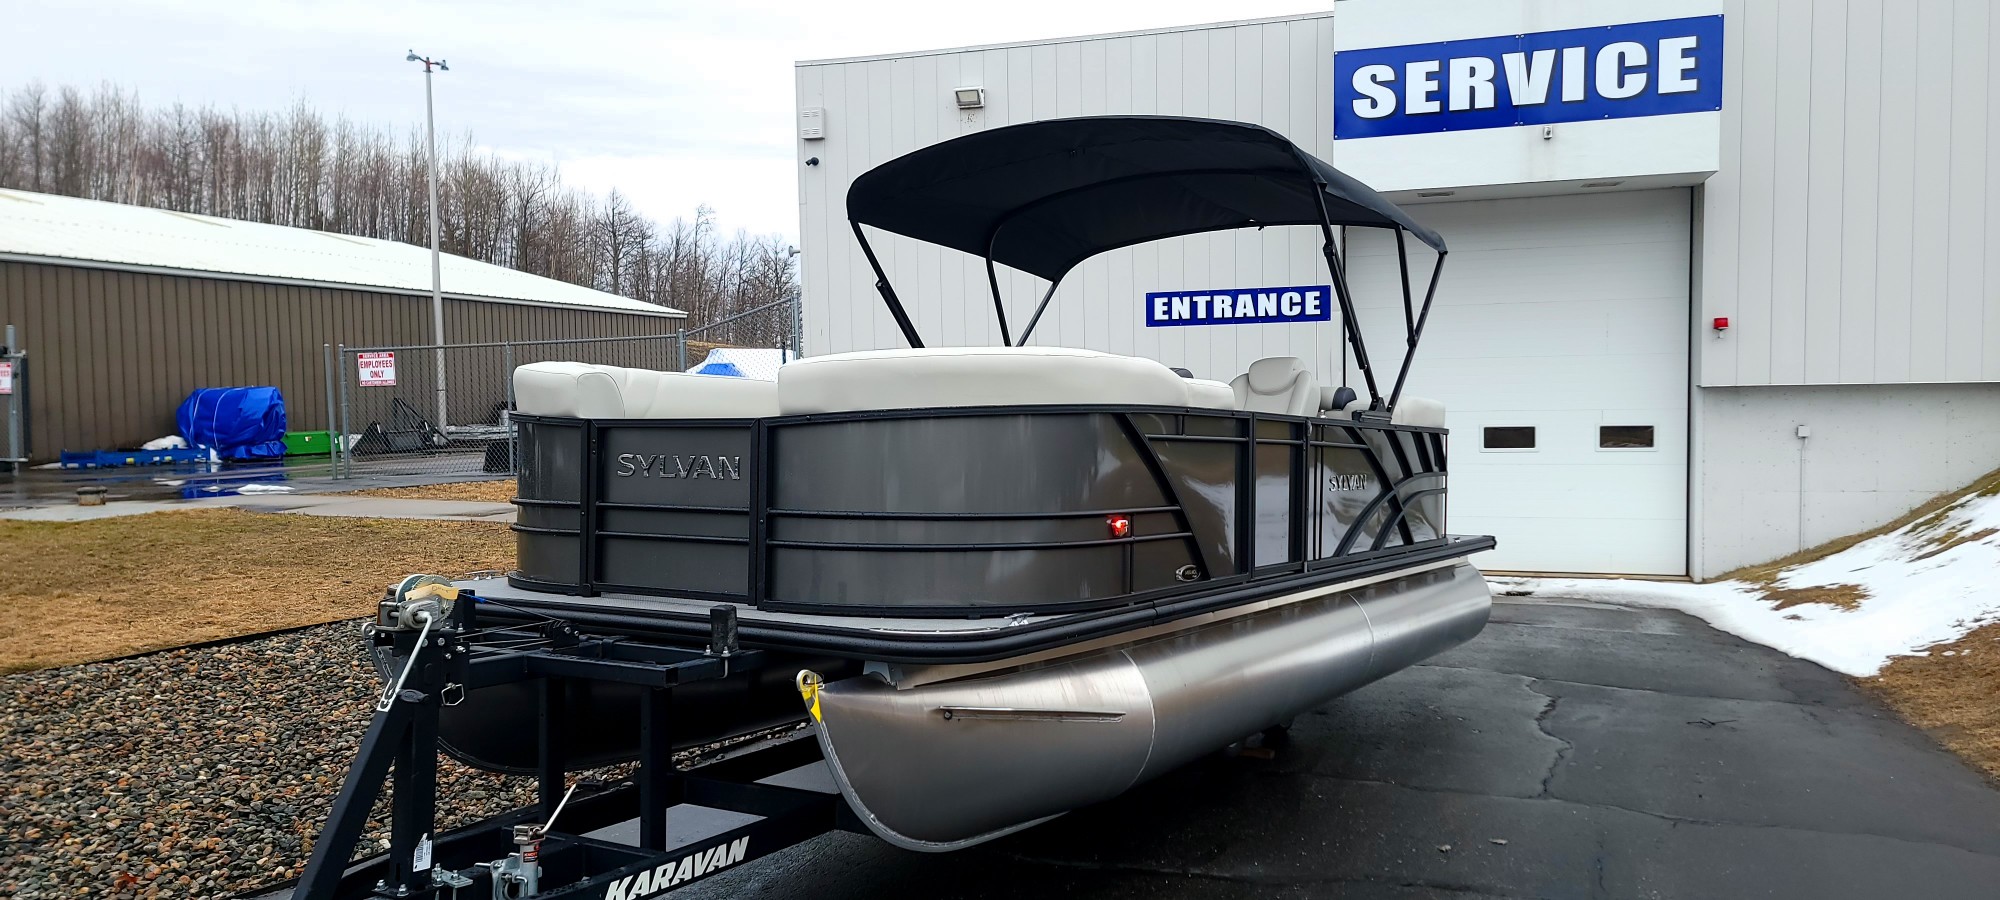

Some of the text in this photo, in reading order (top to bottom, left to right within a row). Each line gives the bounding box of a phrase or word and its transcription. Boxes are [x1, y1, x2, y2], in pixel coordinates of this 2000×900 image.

[1351, 35, 1698, 119] SERVICE
[1153, 290, 1321, 321] ENTRANCE
[360, 359, 392, 368] EMPLOYEES
[370, 370, 384, 378] ONLY
[617, 453, 740, 480] SYLVAN
[1329, 474, 1367, 491] SYLVAN
[605, 835, 750, 900] KARAVAN
